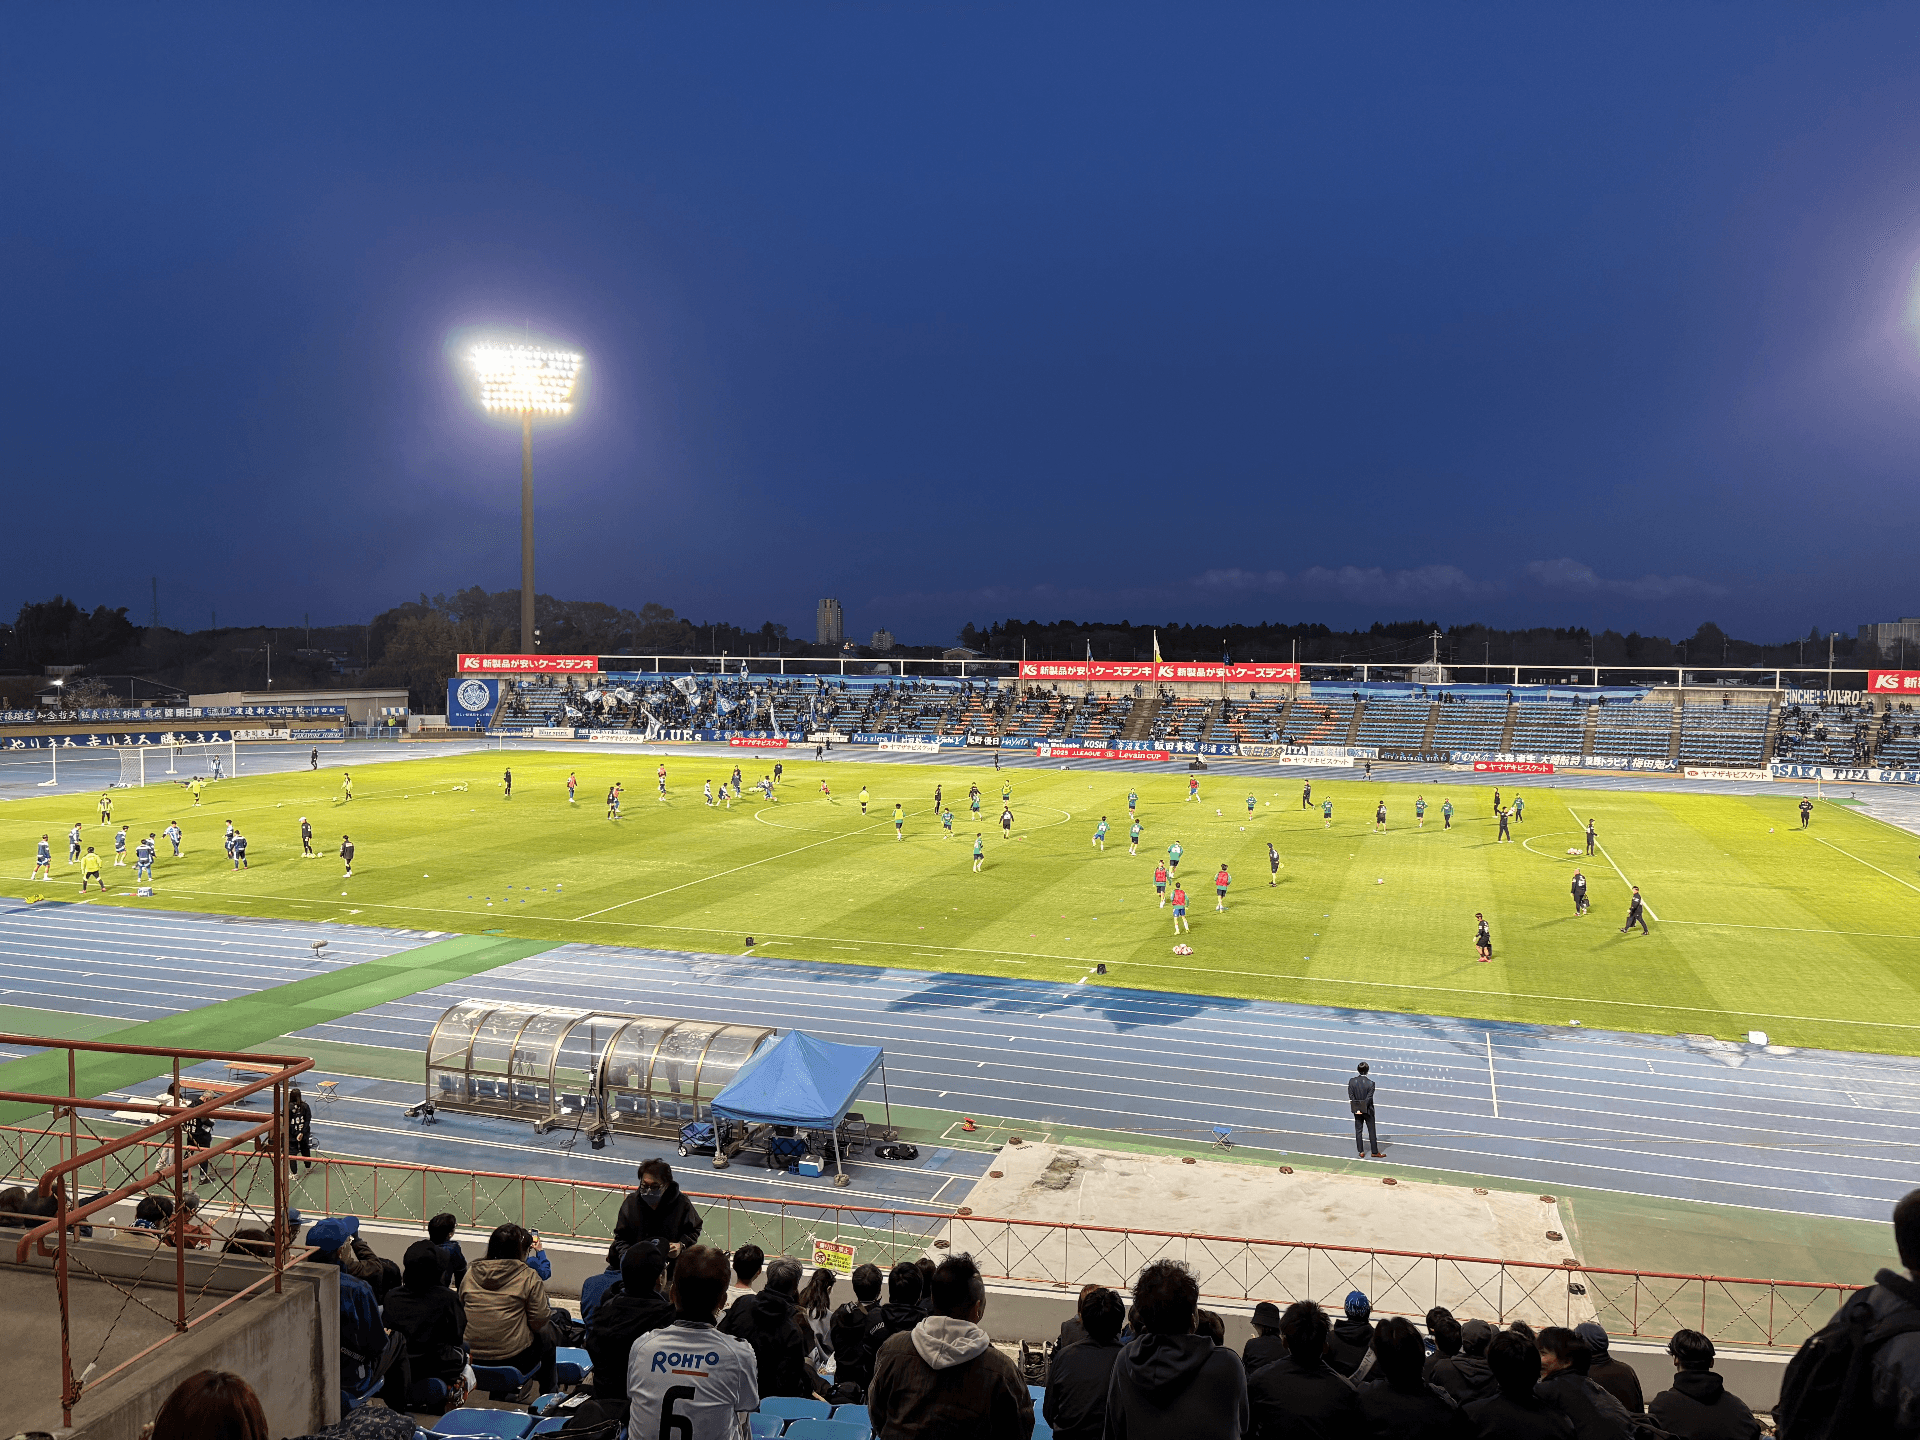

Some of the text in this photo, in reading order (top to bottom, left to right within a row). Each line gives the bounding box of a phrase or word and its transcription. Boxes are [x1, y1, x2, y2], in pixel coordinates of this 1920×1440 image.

[482, 658, 594, 669] 新製品が安いケーズデンキ
[1040, 665, 1152, 677] 新製品が安いケーズデンキ
[1177, 666, 1297, 678] 新製品が安いケーズデンキ
[1904, 677, 1920, 689] 新
[658, 729, 702, 741] LUEs
[741, 739, 783, 747] ヤマザキビスケット
[1084, 740, 1108, 749] KOSHI
[1119, 751, 1146, 759] Levain
[1294, 757, 1349, 766] ヤマザキビスケット
[1489, 763, 1549, 773] ヤマザキビスケット
[1770, 765, 1823, 779] OSAKA
[1832, 769, 1870, 780] TIFA
[1701, 769, 1767, 780] ヤマザキビスケット
[651, 1351, 720, 1374] ROHTO
[659, 1385, 696, 1440] 6
